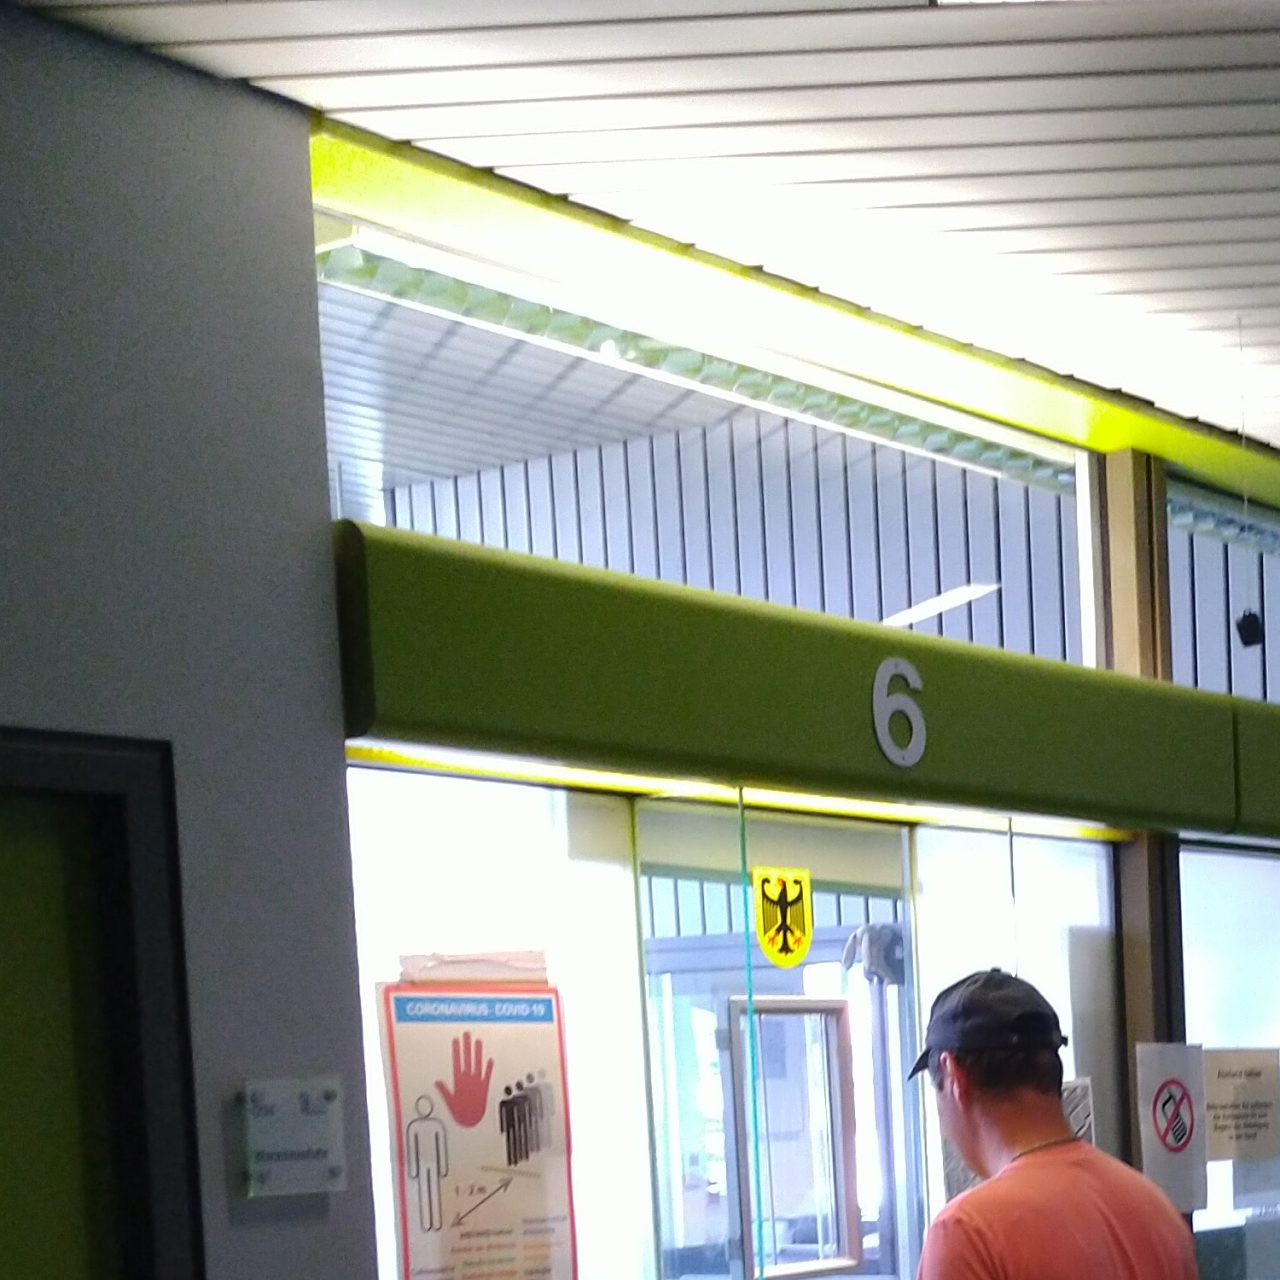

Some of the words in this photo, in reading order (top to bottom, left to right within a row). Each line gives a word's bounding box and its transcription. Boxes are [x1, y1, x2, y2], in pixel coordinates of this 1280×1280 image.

[873, 656, 926, 767] 6
[406, 1001, 489, 1017] CORONAVIRUS
[494, 1001, 546, 1016] COVID-19
